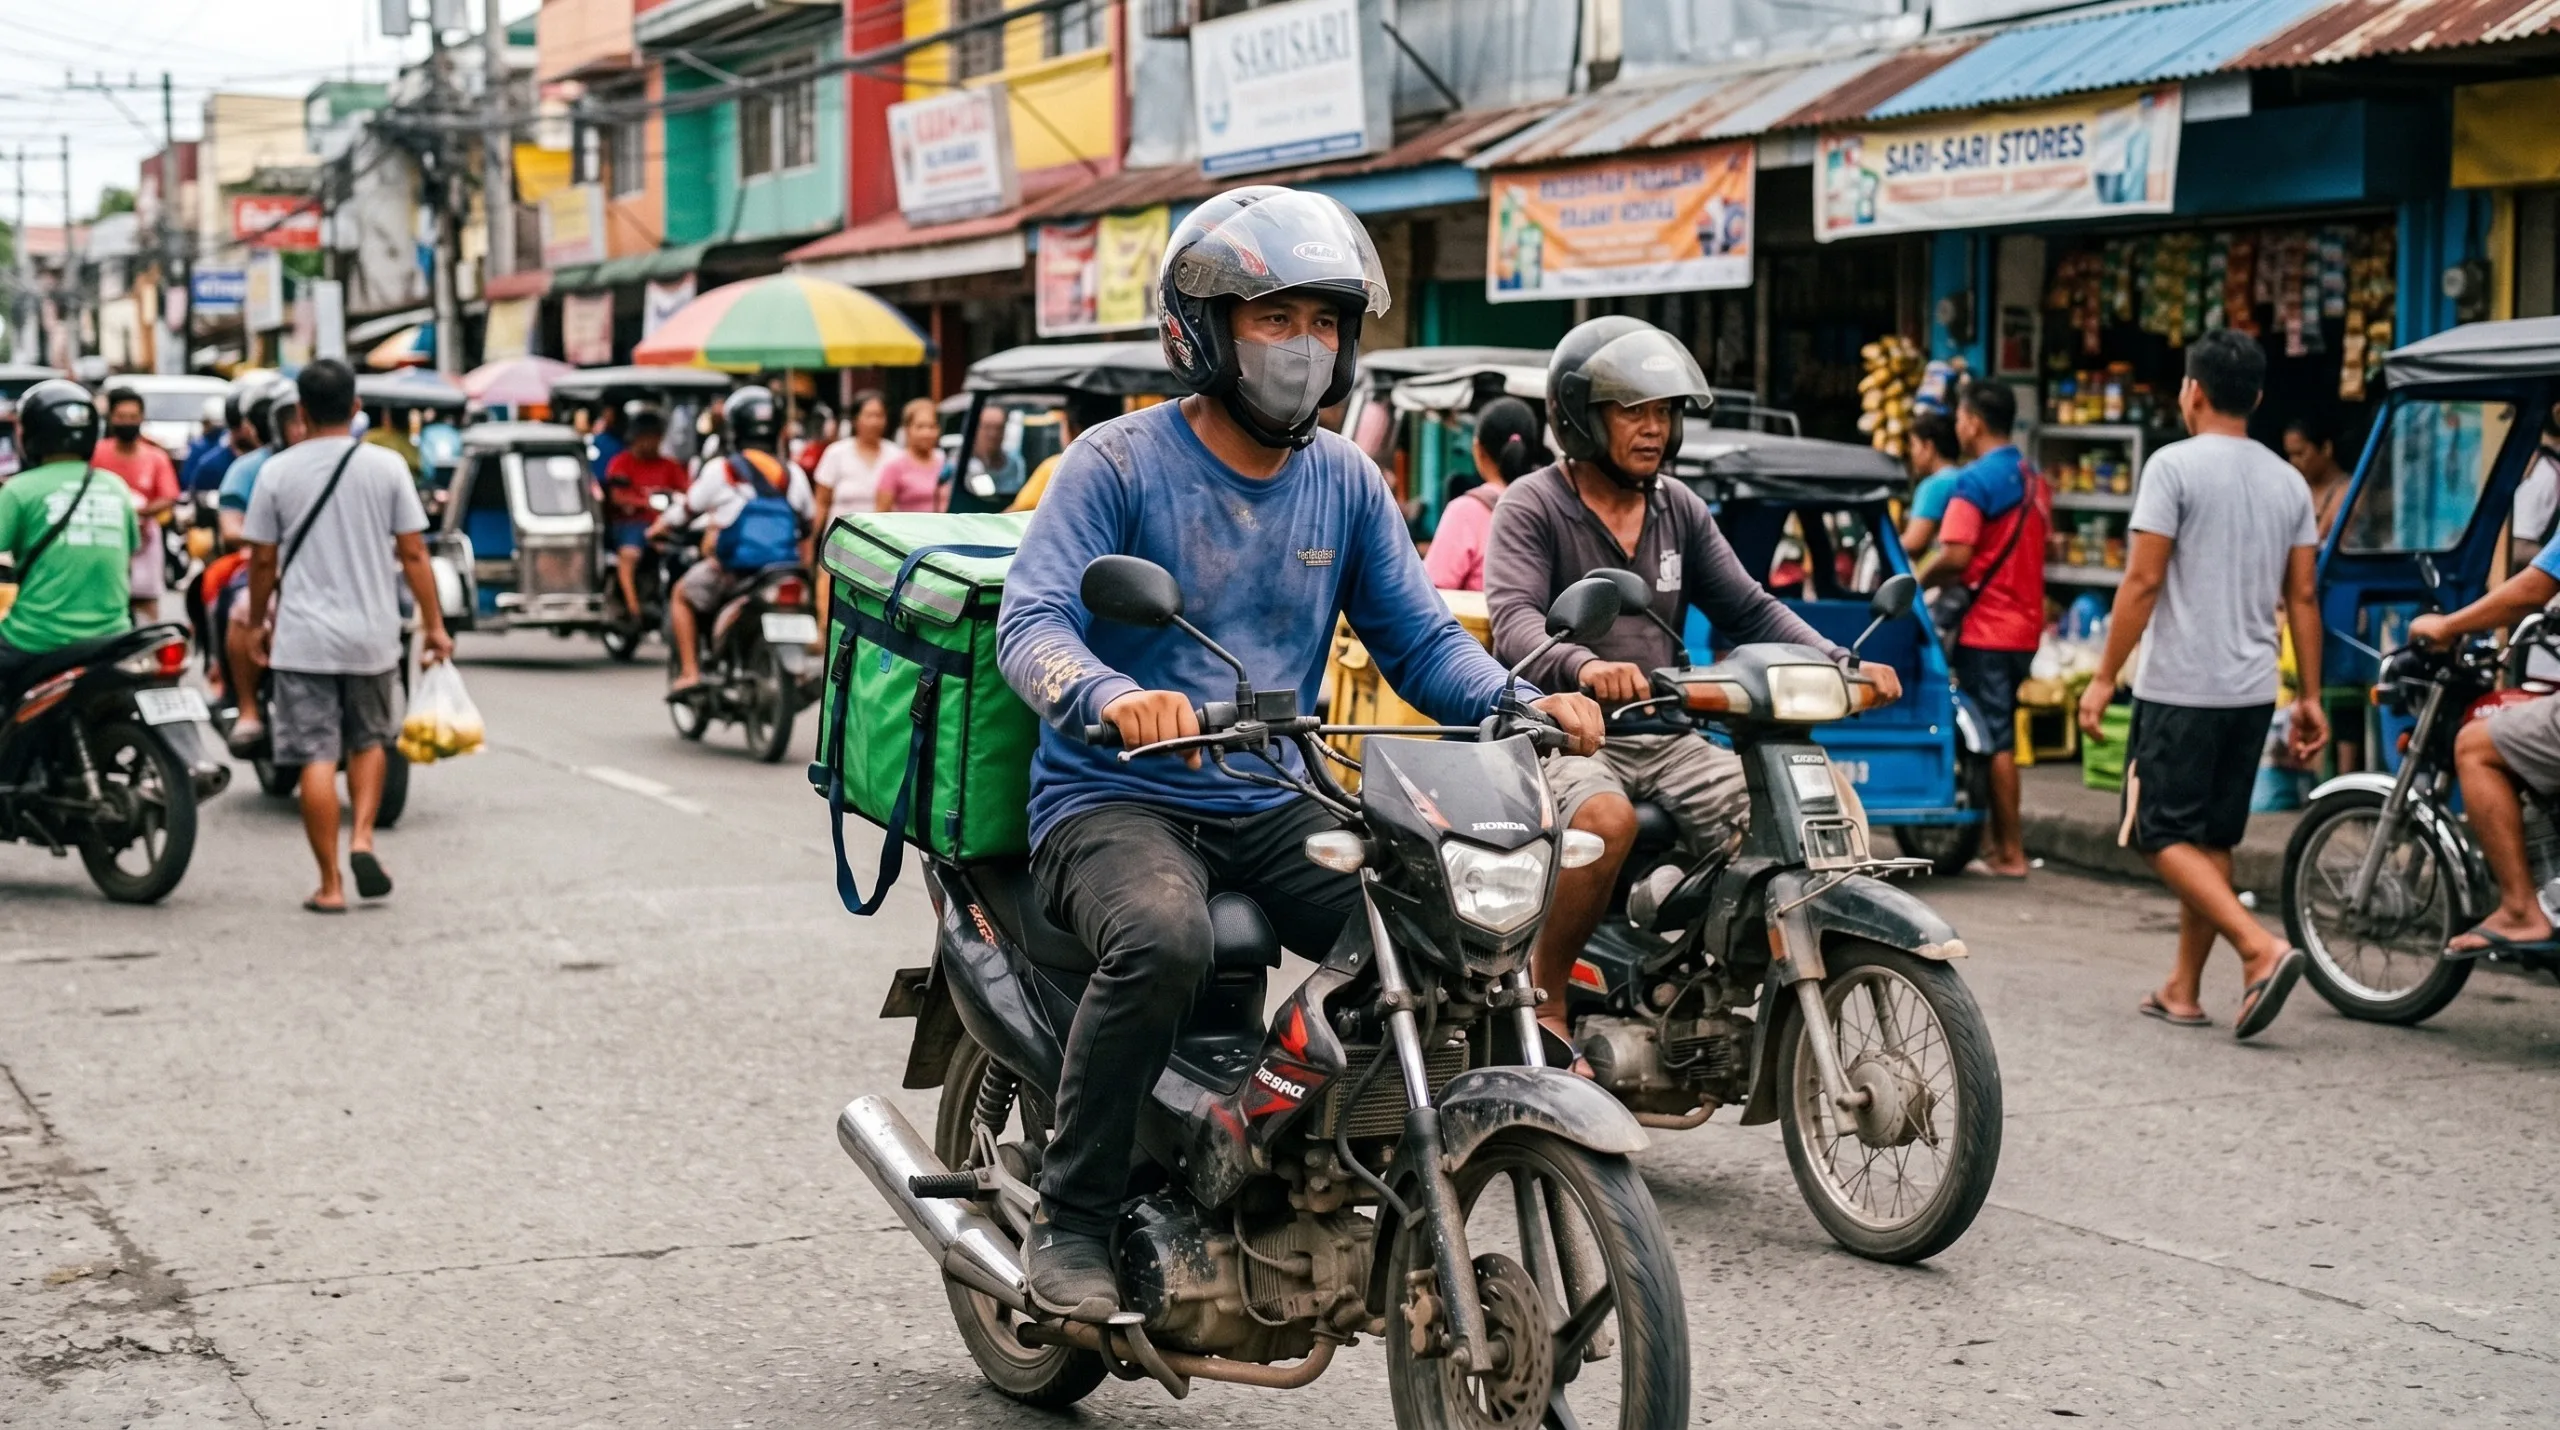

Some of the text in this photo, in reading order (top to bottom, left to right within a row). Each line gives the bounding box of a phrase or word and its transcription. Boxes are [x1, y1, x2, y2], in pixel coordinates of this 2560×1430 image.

[1886, 122, 2085, 176] SARI-SARI STORES
[1471, 821, 1530, 832] HONDA
